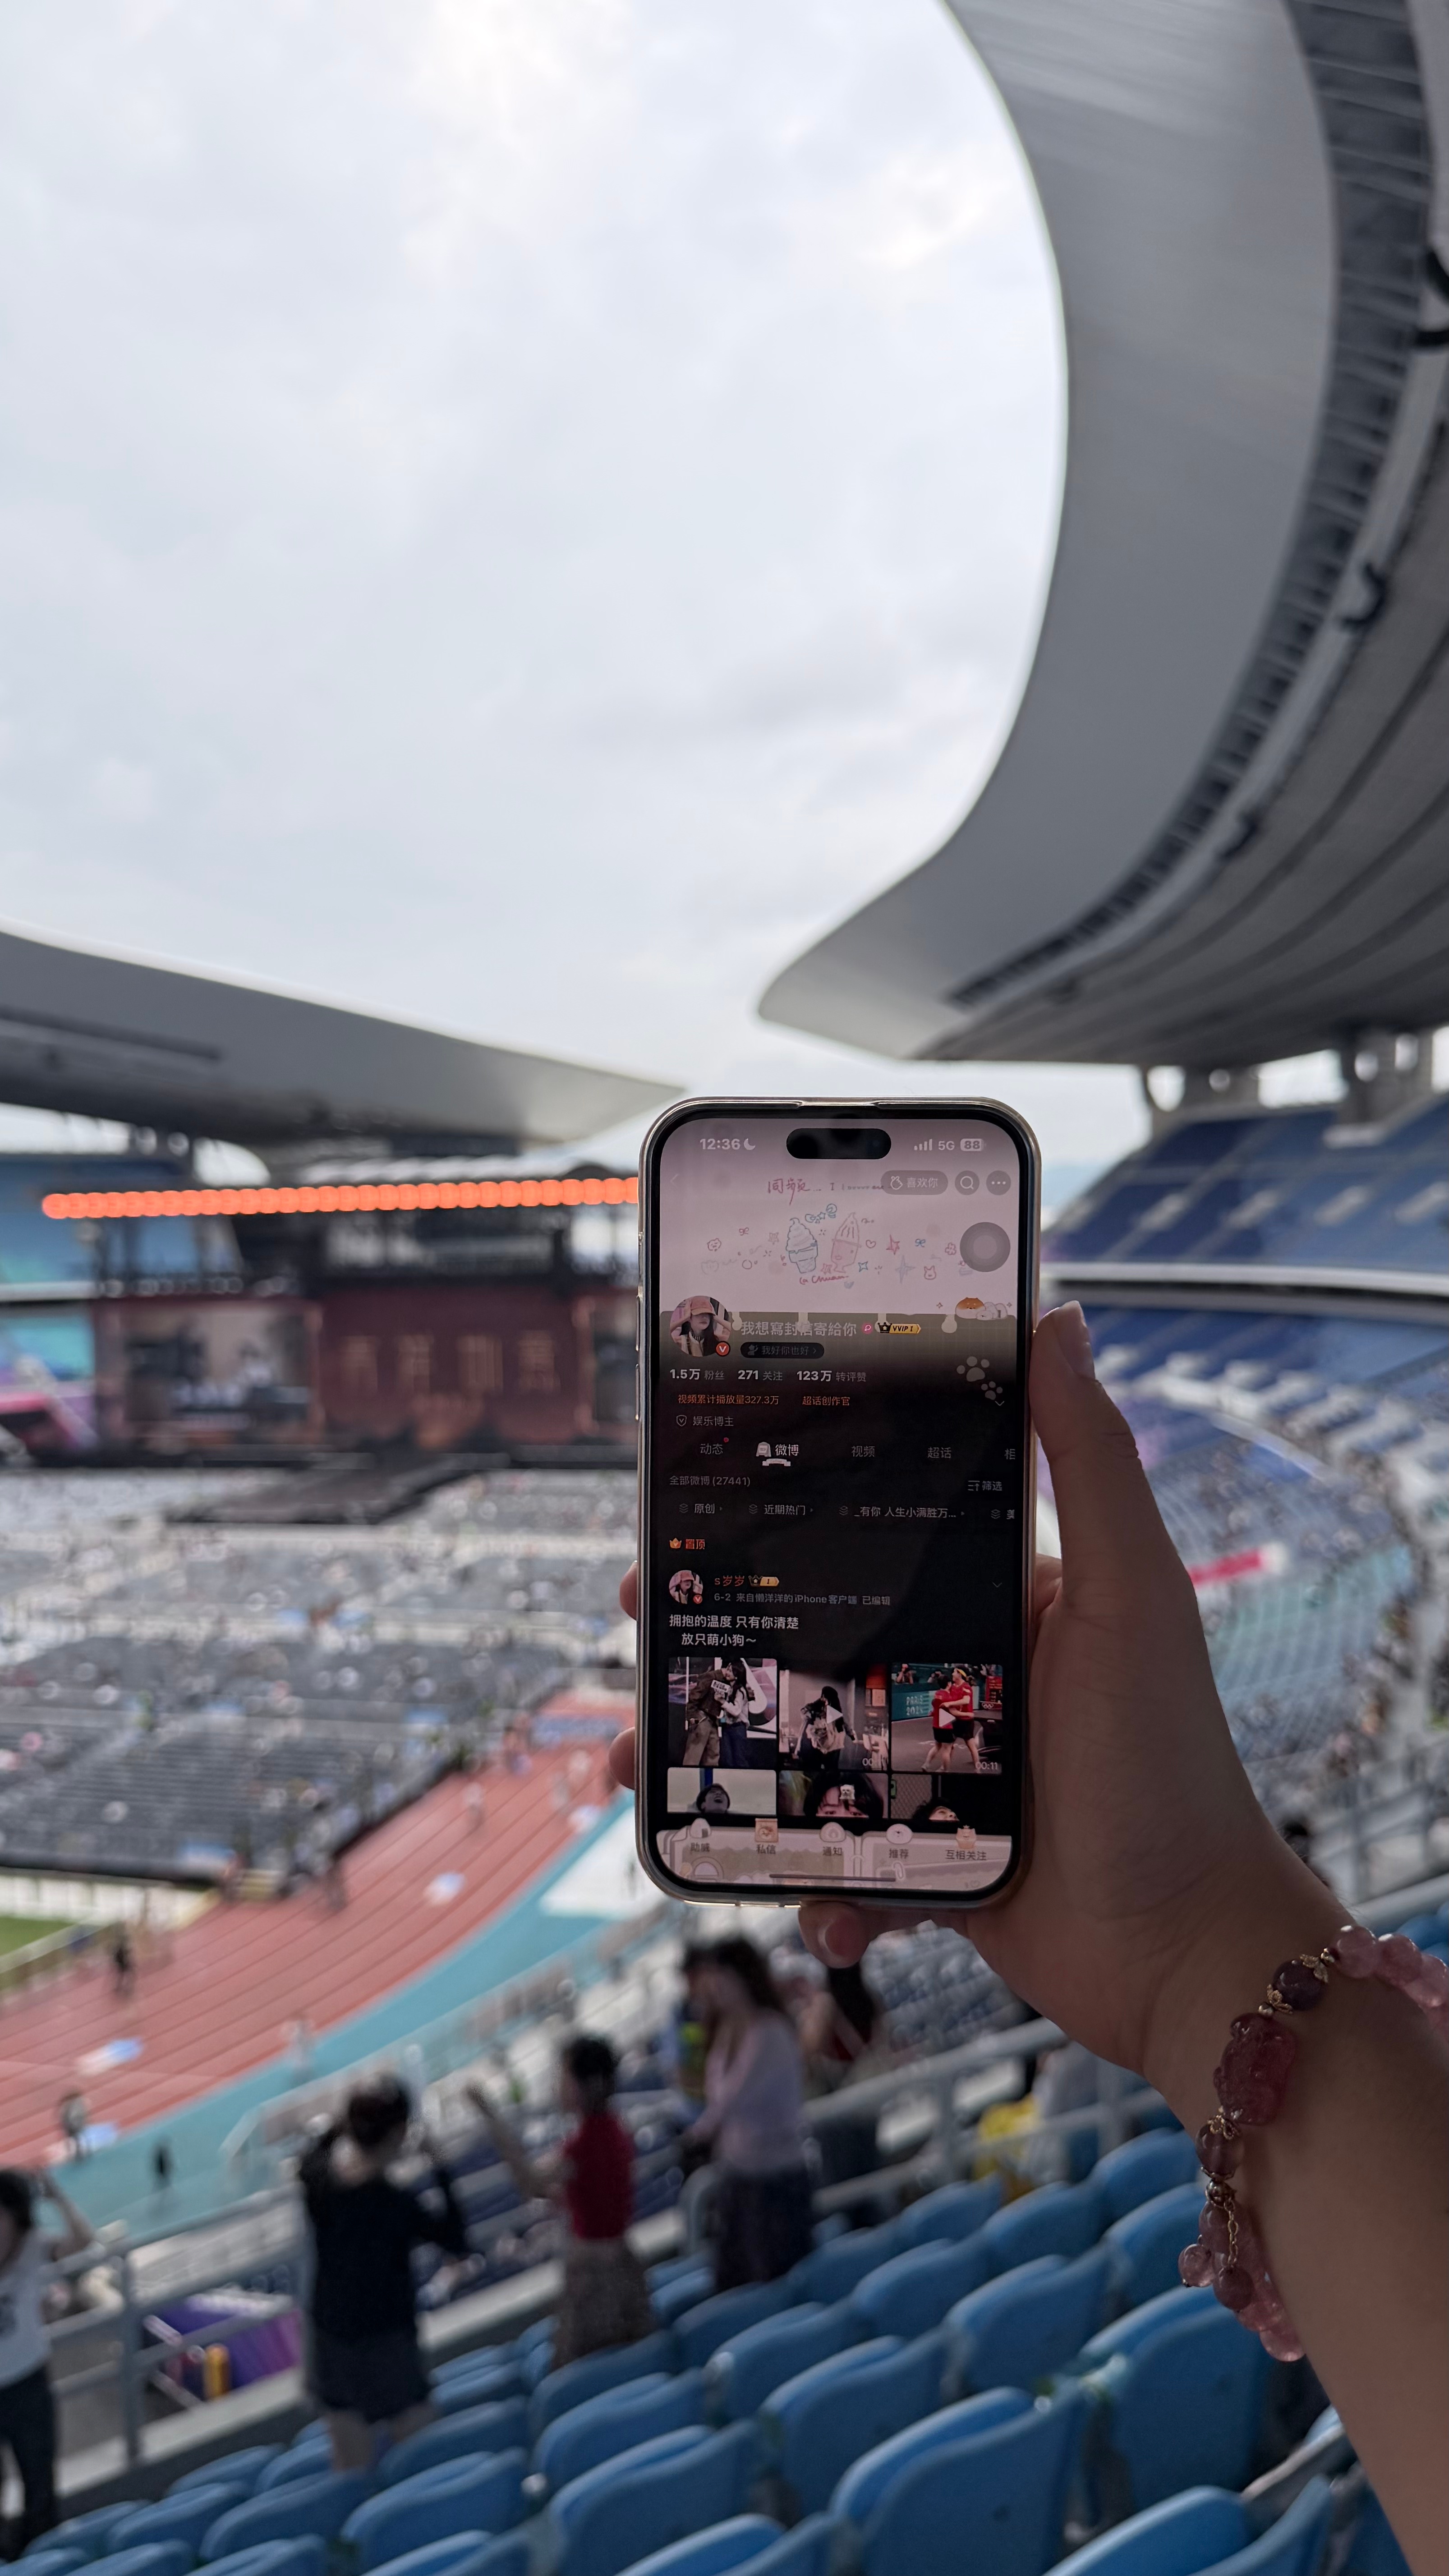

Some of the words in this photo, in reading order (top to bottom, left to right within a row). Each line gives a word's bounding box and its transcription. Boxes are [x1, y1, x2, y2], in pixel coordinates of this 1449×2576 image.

[699, 1138, 741, 1150] 12:36
[938, 1141, 955, 1150] 5G
[964, 1141, 980, 1150] 88
[907, 1177, 938, 1188] 喜欢你
[741, 1321, 857, 1337] 我想寫封信寄給你
[762, 1346, 809, 1356] 我好你也好
[670, 1369, 700, 1380] 1.5万
[704, 1370, 724, 1380] 粉丝
[738, 1370, 759, 1380] 271
[763, 1371, 783, 1381] 关注
[797, 1370, 832, 1382] 123万
[836, 1371, 866, 1382] 转评赞
[802, 1396, 850, 1406] 超话创作官
[693, 1416, 734, 1426] 娱乐博主
[700, 1443, 723, 1455] 动态
[775, 1444, 799, 1456] 微博
[851, 1445, 875, 1457] 视频
[927, 1447, 952, 1458] 超话
[669, 1476, 710, 1486] 全部微博
[713, 1477, 750, 1487] (27441)
[982, 1481, 1003, 1491] 筛选
[694, 1503, 715, 1514] 原创
[764, 1504, 805, 1515] 近期热门
[685, 1538, 705, 1550] 置顶
[714, 1593, 731, 1601] 6-2
[862, 1596, 890, 1605] 已编辑
[669, 1614, 732, 1628] 拥抱的温度
[736, 1616, 799, 1629] 只有你清楚
[756, 1844, 776, 1855] 私信
[822, 1847, 842, 1857] 通知
[889, 1849, 909, 1859] 推荐
[946, 1849, 987, 1861] 互相关注
